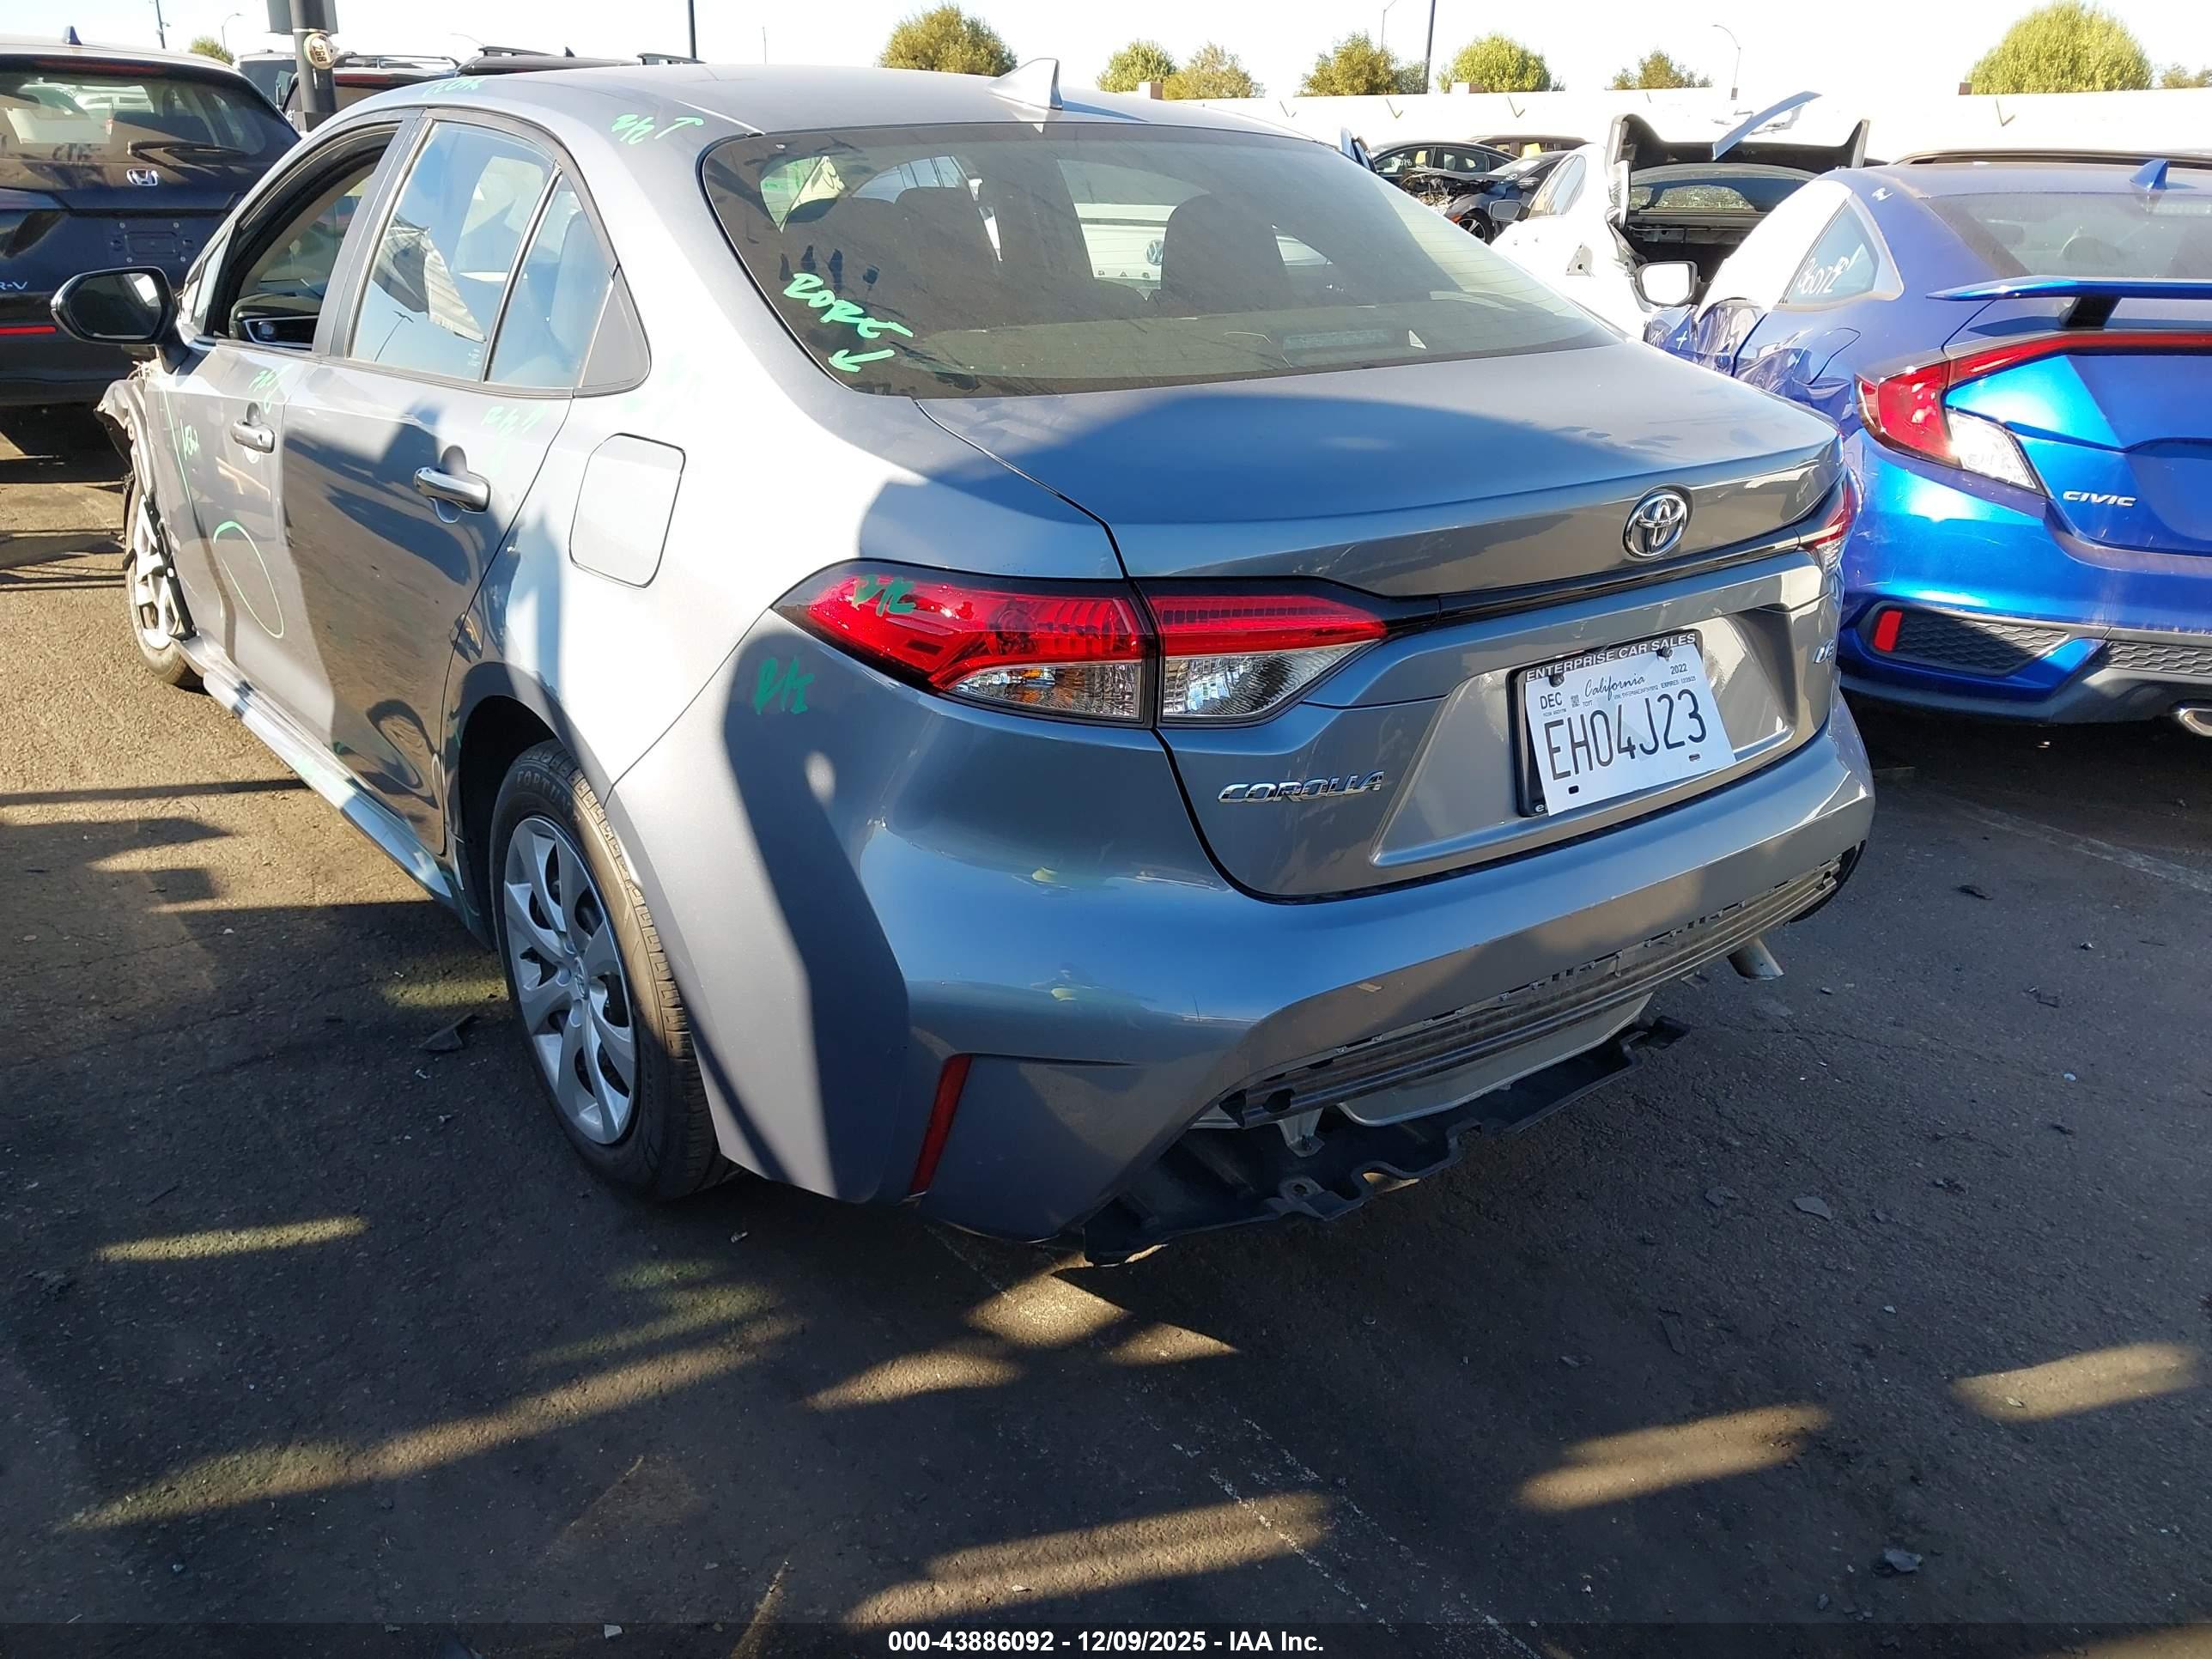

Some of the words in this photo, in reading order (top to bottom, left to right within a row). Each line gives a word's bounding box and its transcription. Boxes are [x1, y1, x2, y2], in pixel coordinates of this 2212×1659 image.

[2063, 489, 2137, 507] CIVIC
[1526, 649, 1615, 683] ENTERPRISE
[1618, 642, 1648, 659] CAR
[1650, 633, 1697, 651] SALES
[1669, 663, 1688, 676] 2022
[1540, 692, 1563, 710] DEC
[1584, 672, 1646, 701] California
[1544, 689, 1707, 781] EH04J23
[1218, 770, 1385, 803] COROLLA
